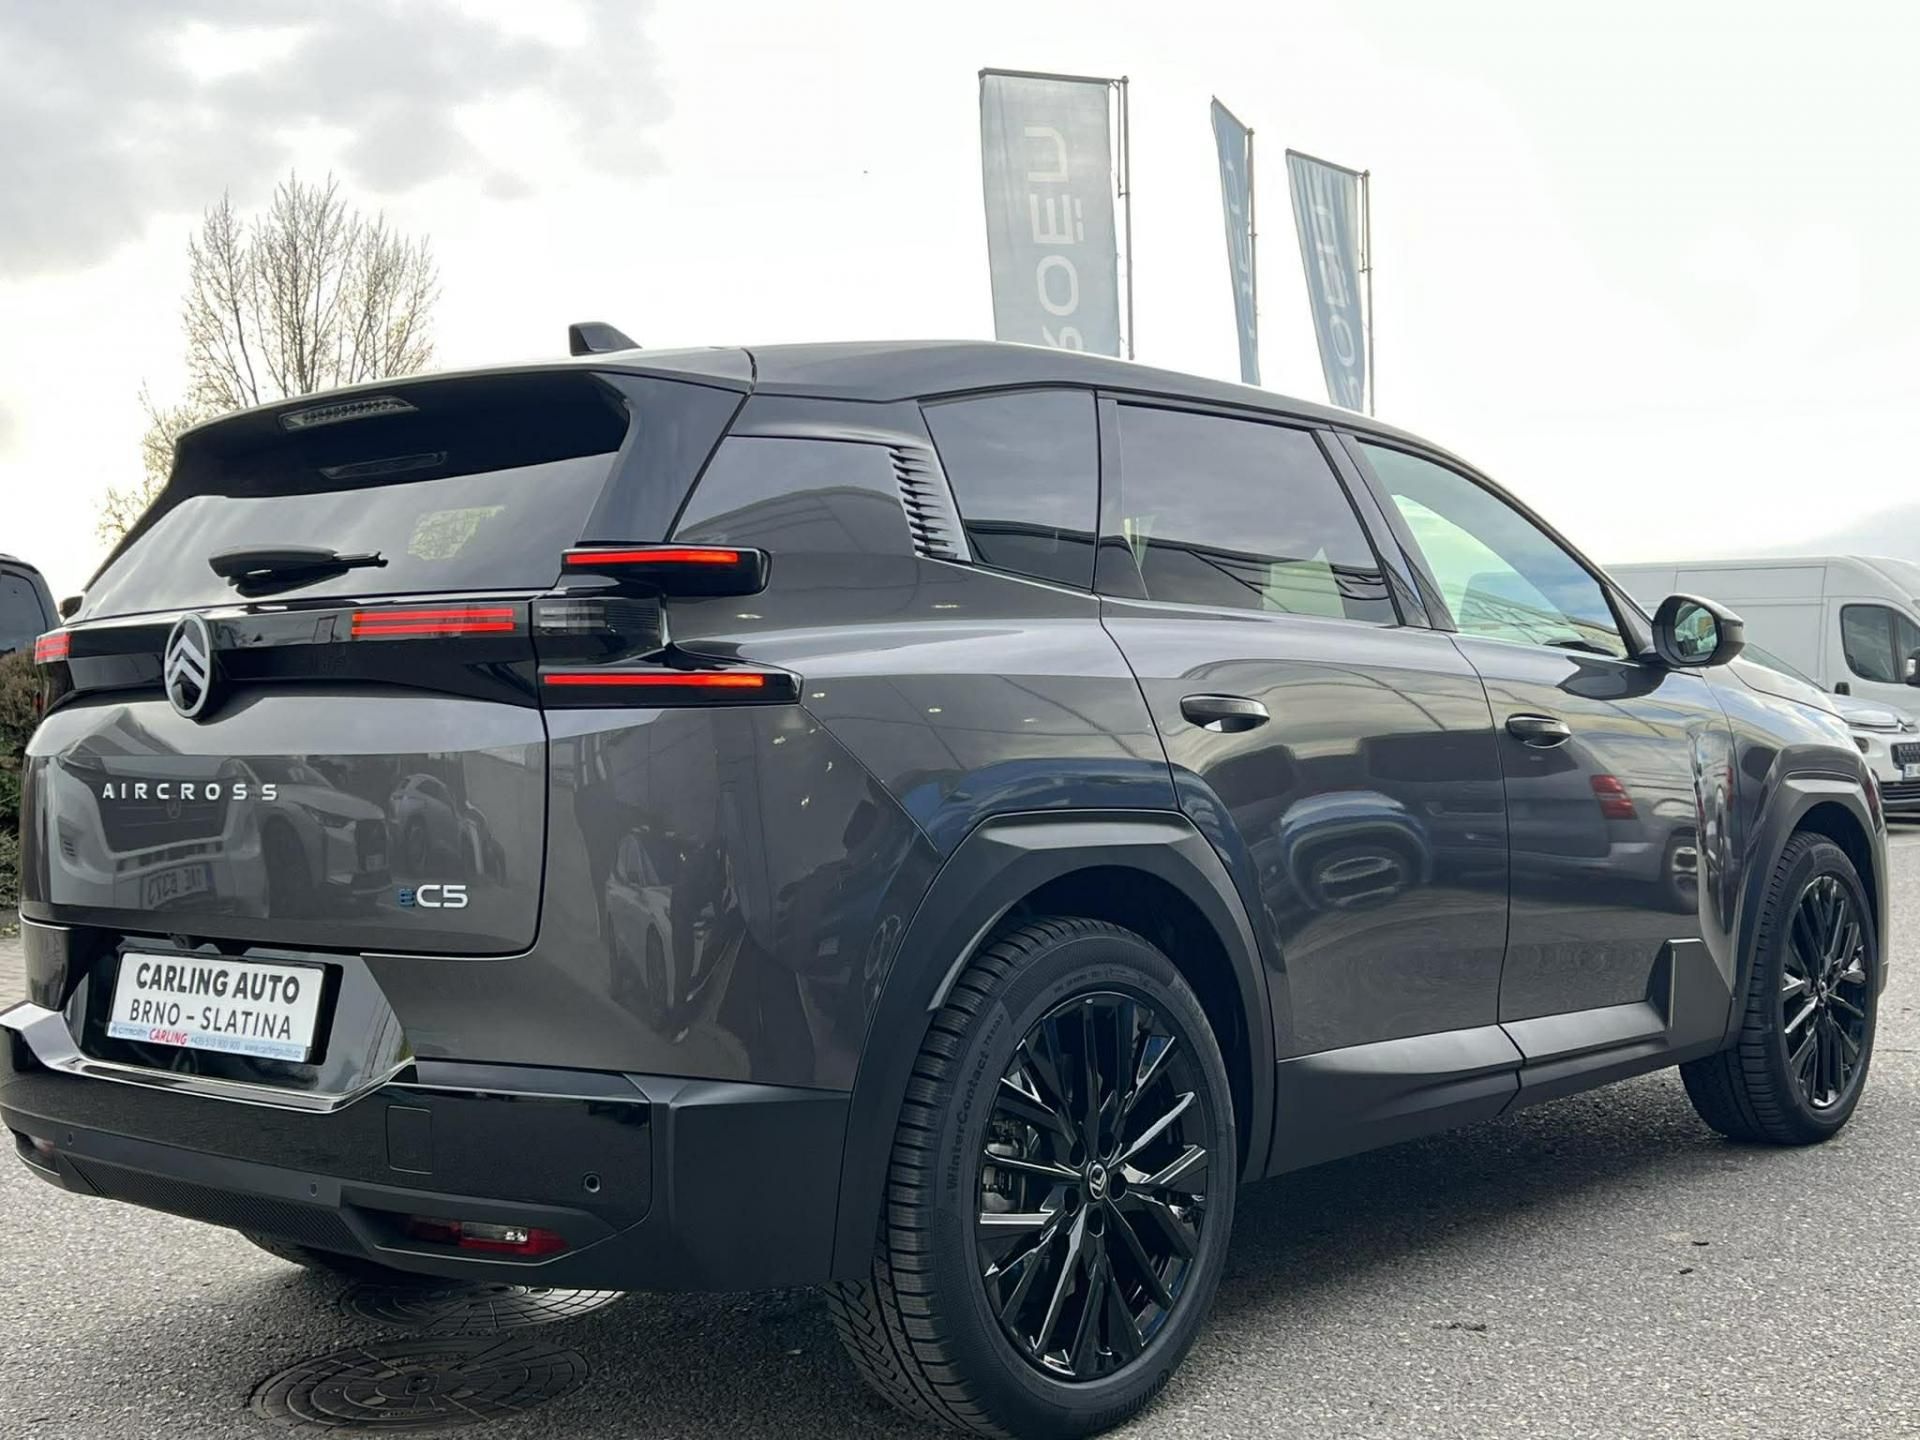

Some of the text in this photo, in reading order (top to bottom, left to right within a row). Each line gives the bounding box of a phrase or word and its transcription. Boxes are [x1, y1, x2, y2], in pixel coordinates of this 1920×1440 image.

[102, 783, 277, 800] AIRCROSS
[136, 962, 300, 1005] CARLING AUTO
[129, 998, 180, 1027] BRNO
[200, 1006, 291, 1040] SLATINA
[149, 1027, 187, 1046] CARLING
